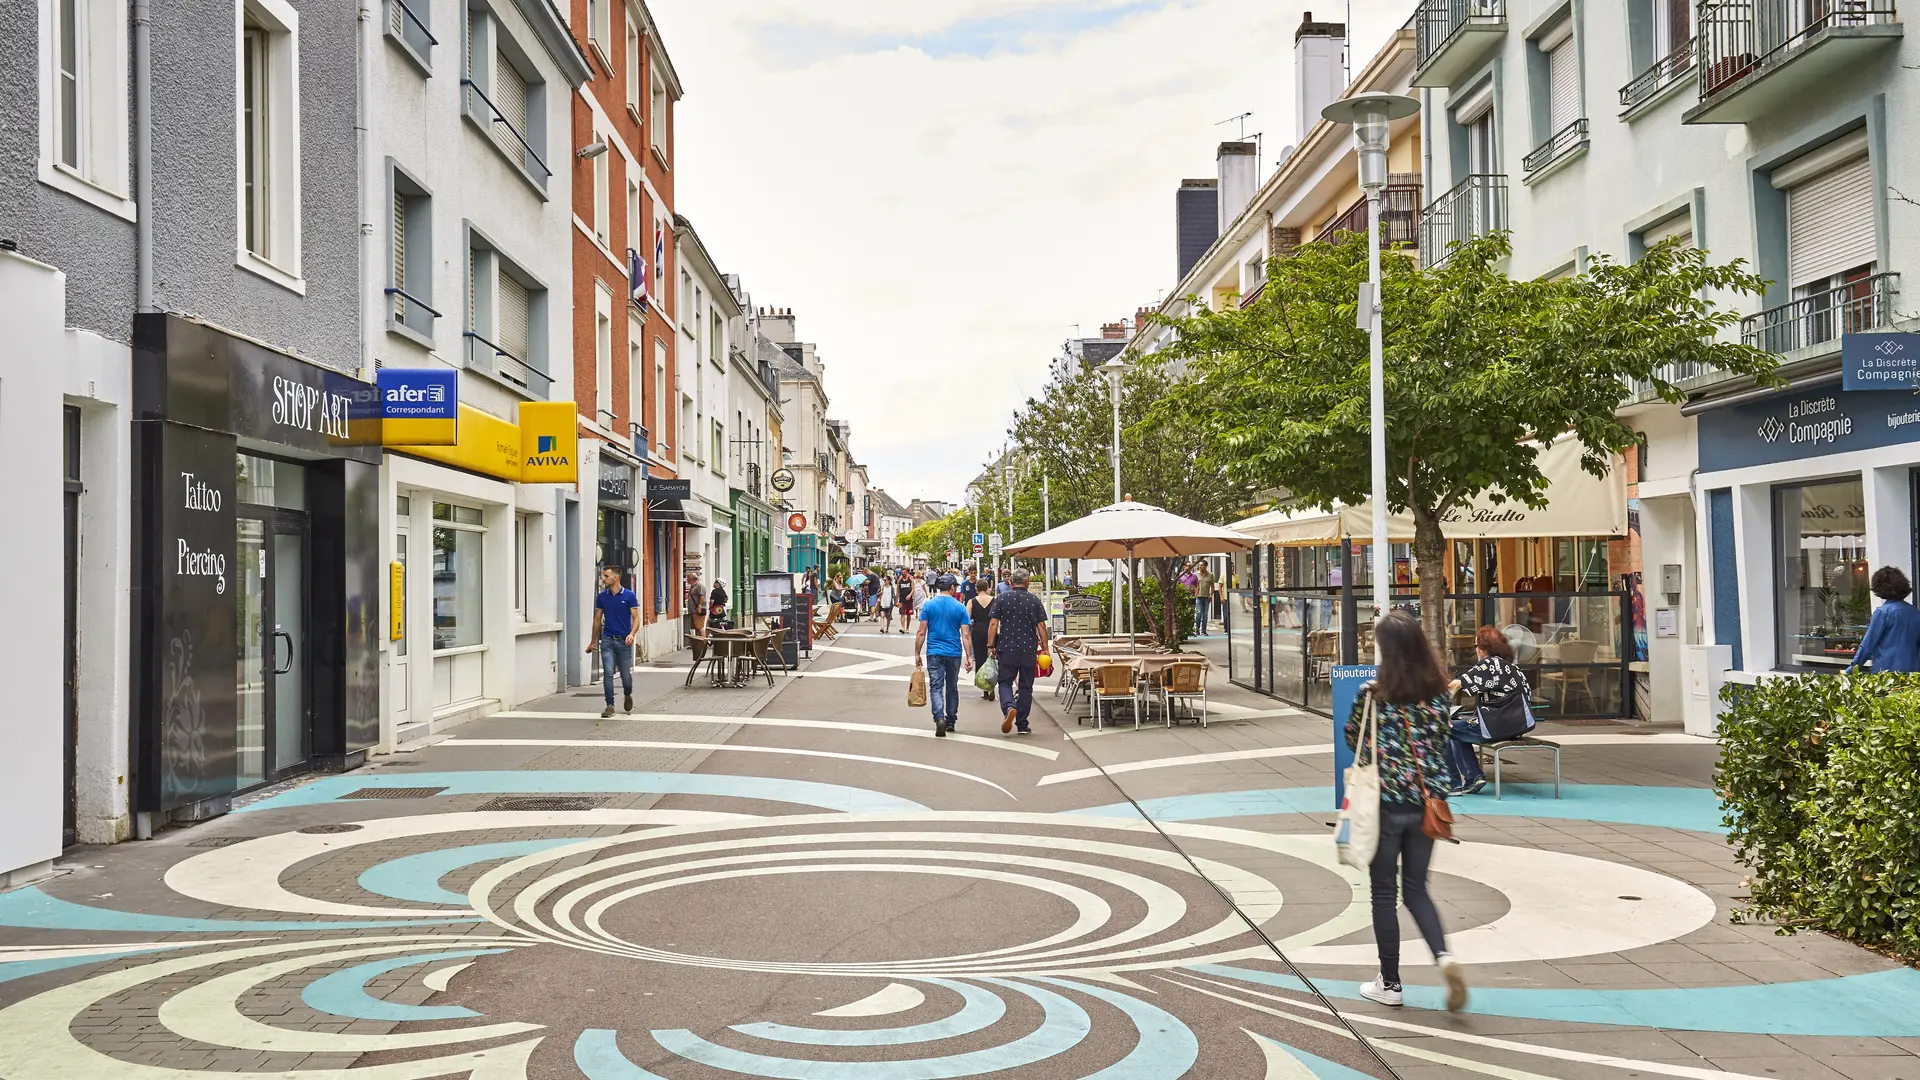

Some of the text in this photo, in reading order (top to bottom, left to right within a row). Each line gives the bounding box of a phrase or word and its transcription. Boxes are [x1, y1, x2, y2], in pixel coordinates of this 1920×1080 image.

[1862, 358, 1917, 368] La Discrète
[386, 384, 426, 402] afer
[386, 405, 445, 414] Correspondant
[1789, 397, 1836, 419] La Discrète
[1789, 413, 1852, 445] Compagnie
[526, 456, 569, 467] AVIVA
[181, 471, 222, 512] Tattoo
[1440, 508, 1526, 523] Le Rialto
[177, 538, 226, 595] Piercing
[1332, 667, 1377, 680] bijouterie
